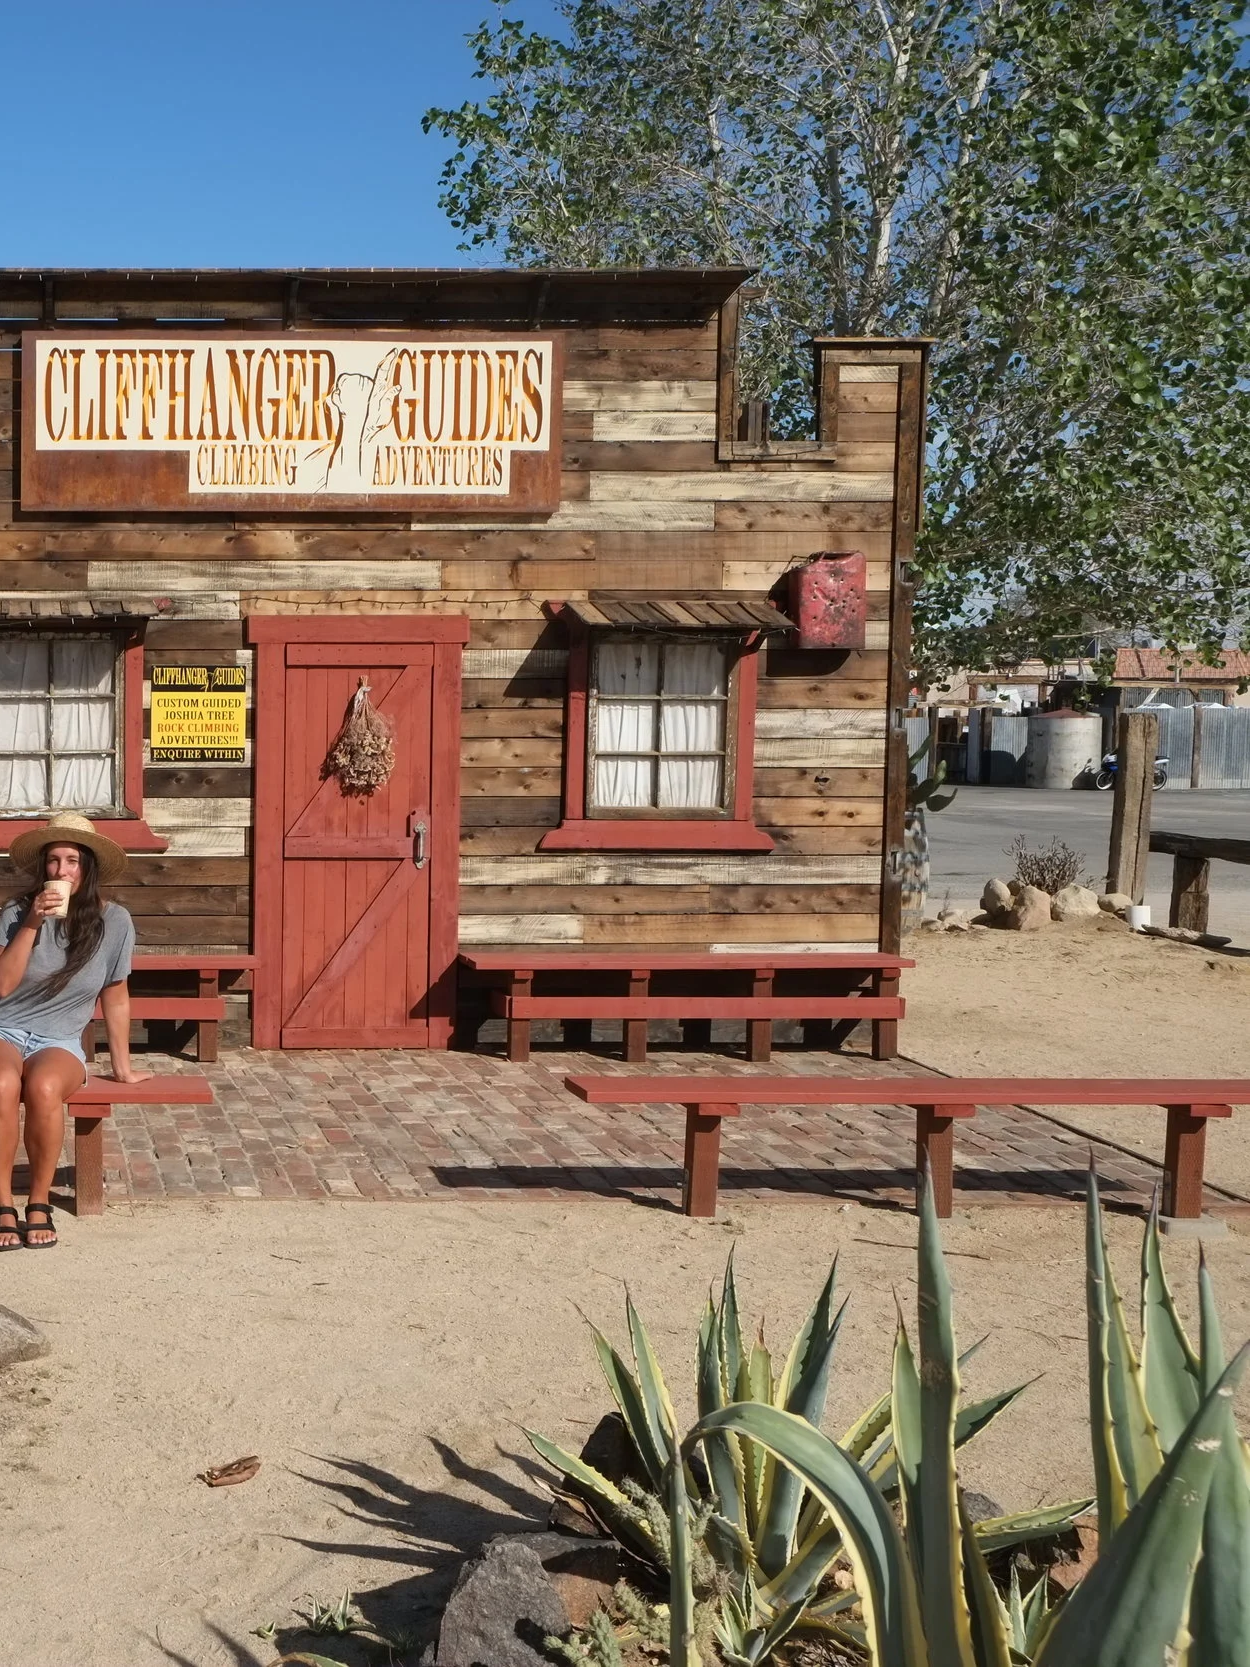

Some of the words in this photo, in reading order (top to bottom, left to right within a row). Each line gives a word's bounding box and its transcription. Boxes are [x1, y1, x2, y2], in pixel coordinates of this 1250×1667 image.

[44, 347, 336, 442] CLIFFHANGER
[392, 347, 543, 443] GUIDES
[196, 444, 298, 486] CLIMBING
[372, 445, 503, 486] ADVENTURES
[153, 668, 207, 685] CLIFFHANGER
[217, 667, 244, 685] GUIDES
[157, 699, 198, 708] CUSTOM
[202, 699, 241, 708] GUIDED
[164, 711, 204, 721] JOSHUA
[207, 711, 234, 720] TREE
[157, 723, 184, 732] ROCK
[188, 724, 239, 732] CLIMBING
[159, 736, 238, 744] ADVENTURES!!!
[153, 749, 201, 760] ENQUIRE
[205, 749, 243, 758] WITHIN
